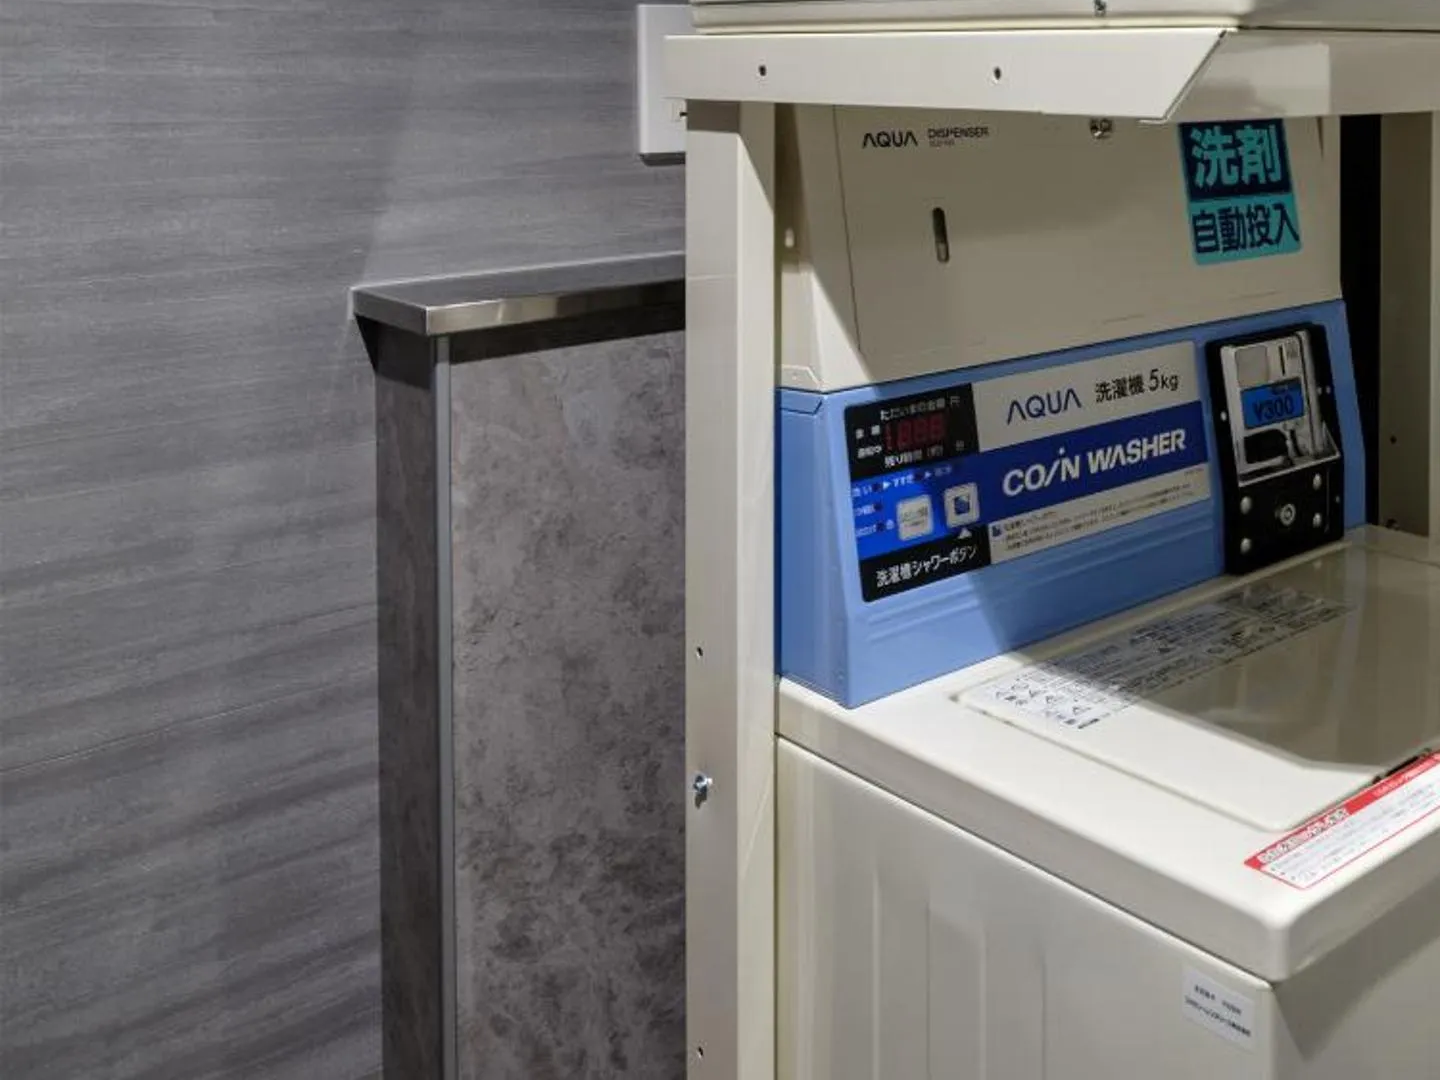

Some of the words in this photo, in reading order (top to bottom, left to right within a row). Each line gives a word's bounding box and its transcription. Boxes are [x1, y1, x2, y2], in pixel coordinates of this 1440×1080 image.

[862, 130, 918, 149] AQUA
[928, 126, 989, 139] DISPENSER
[1190, 124, 1282, 188] 洗剤
[1192, 202, 1301, 254] 自動投入
[1007, 387, 1082, 426] AQUA
[1095, 374, 1144, 403] 洗濯機
[1149, 368, 1180, 392] 5kg
[1087, 427, 1187, 475] WASHER
